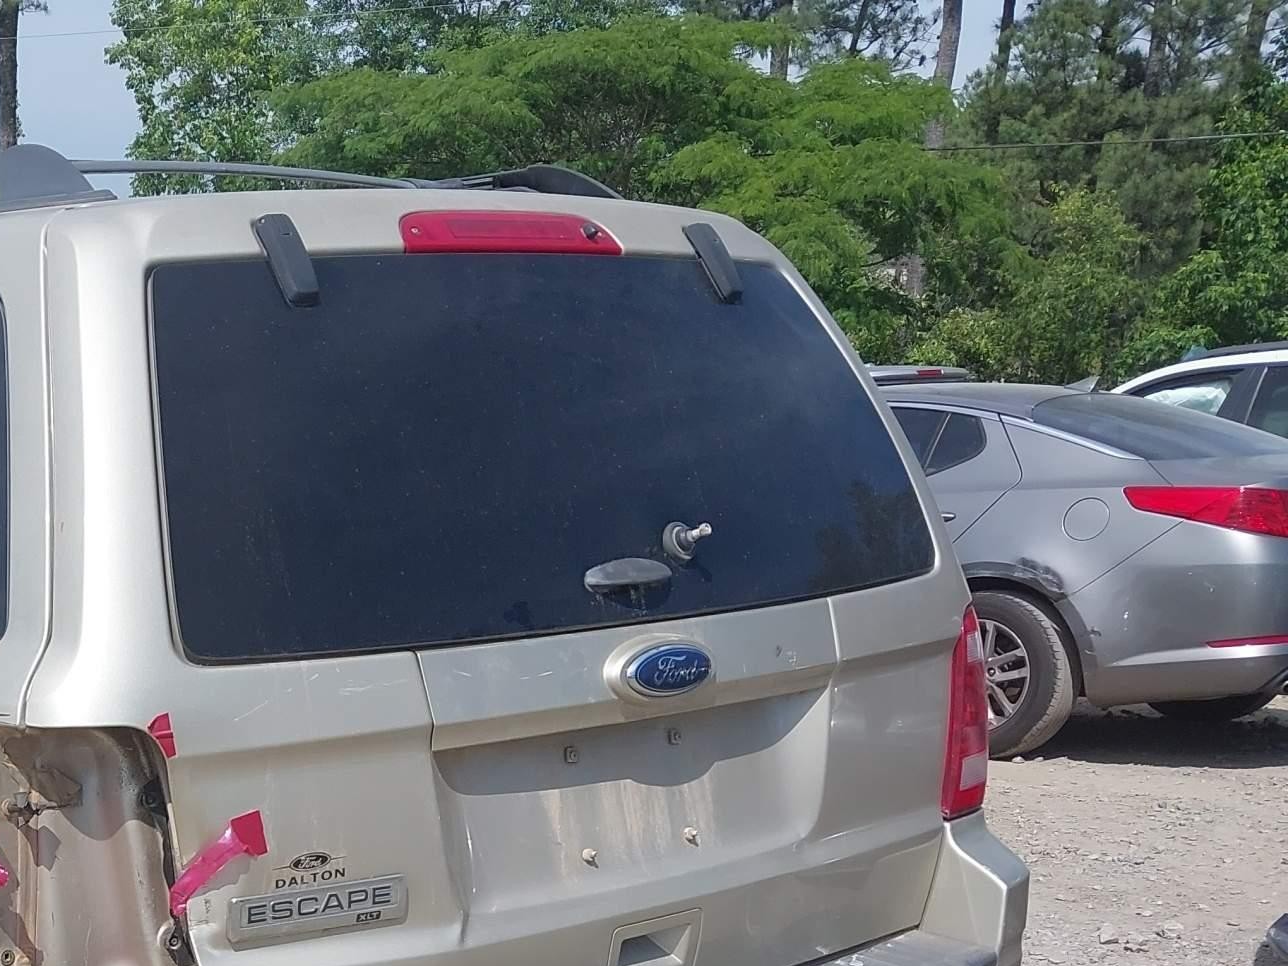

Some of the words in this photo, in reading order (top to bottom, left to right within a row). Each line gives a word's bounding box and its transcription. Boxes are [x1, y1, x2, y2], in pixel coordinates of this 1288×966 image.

[654, 655, 699, 686] Ford
[275, 868, 346, 889] DALTON
[247, 885, 392, 924] ESCAPE
[357, 910, 381, 921] XLT
